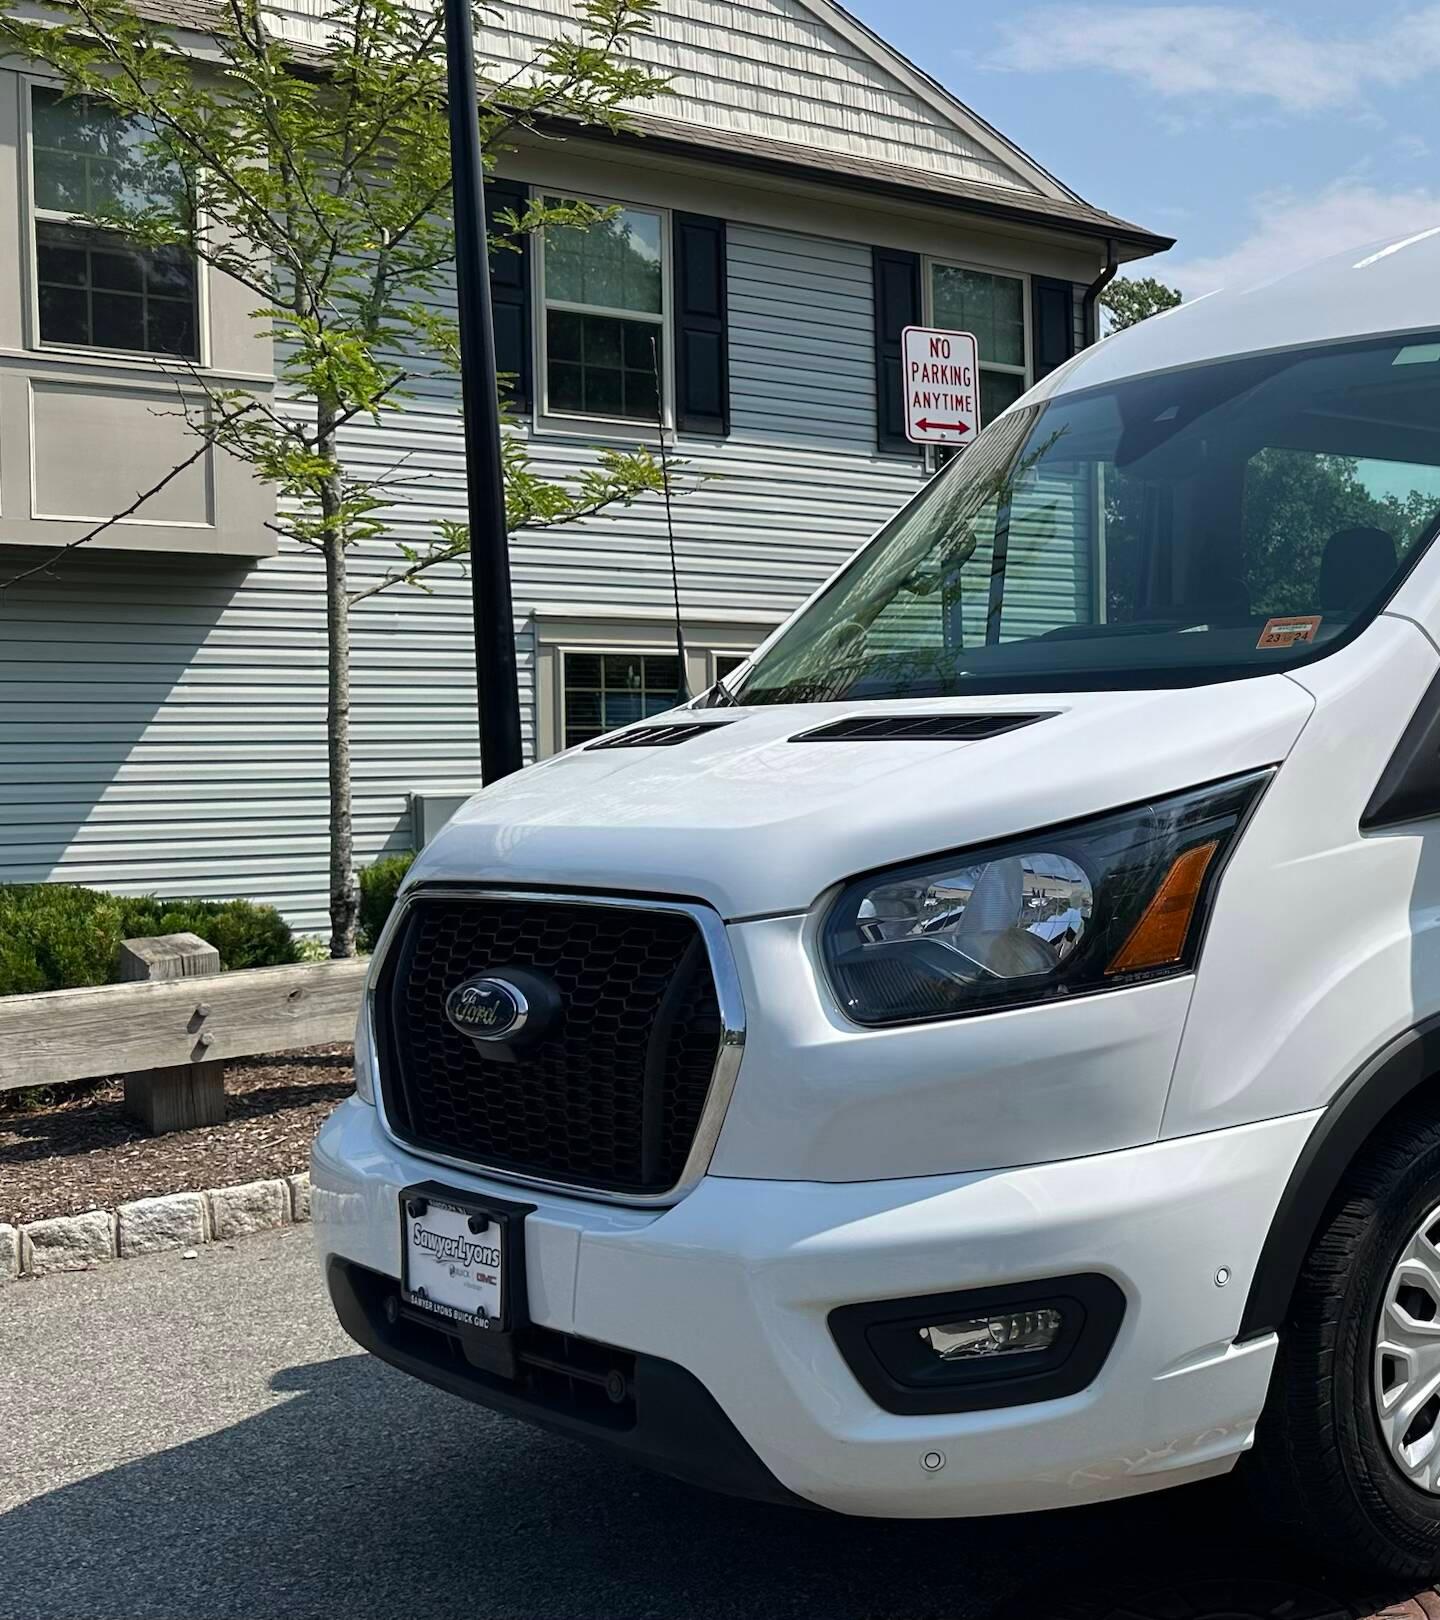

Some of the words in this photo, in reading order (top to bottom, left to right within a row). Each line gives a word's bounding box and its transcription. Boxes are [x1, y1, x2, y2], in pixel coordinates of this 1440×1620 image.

[930, 338, 951, 359] NO
[911, 361, 971, 387] PARKING
[913, 391, 973, 412] ANYTIME
[1266, 634, 1281, 642] 23
[455, 987, 500, 1025] Ford
[411, 1294, 433, 1311] SAWYER
[433, 1303, 453, 1317] LYONS
[454, 1309, 473, 1324] BUICK
[473, 1317, 490, 1329] GMC
